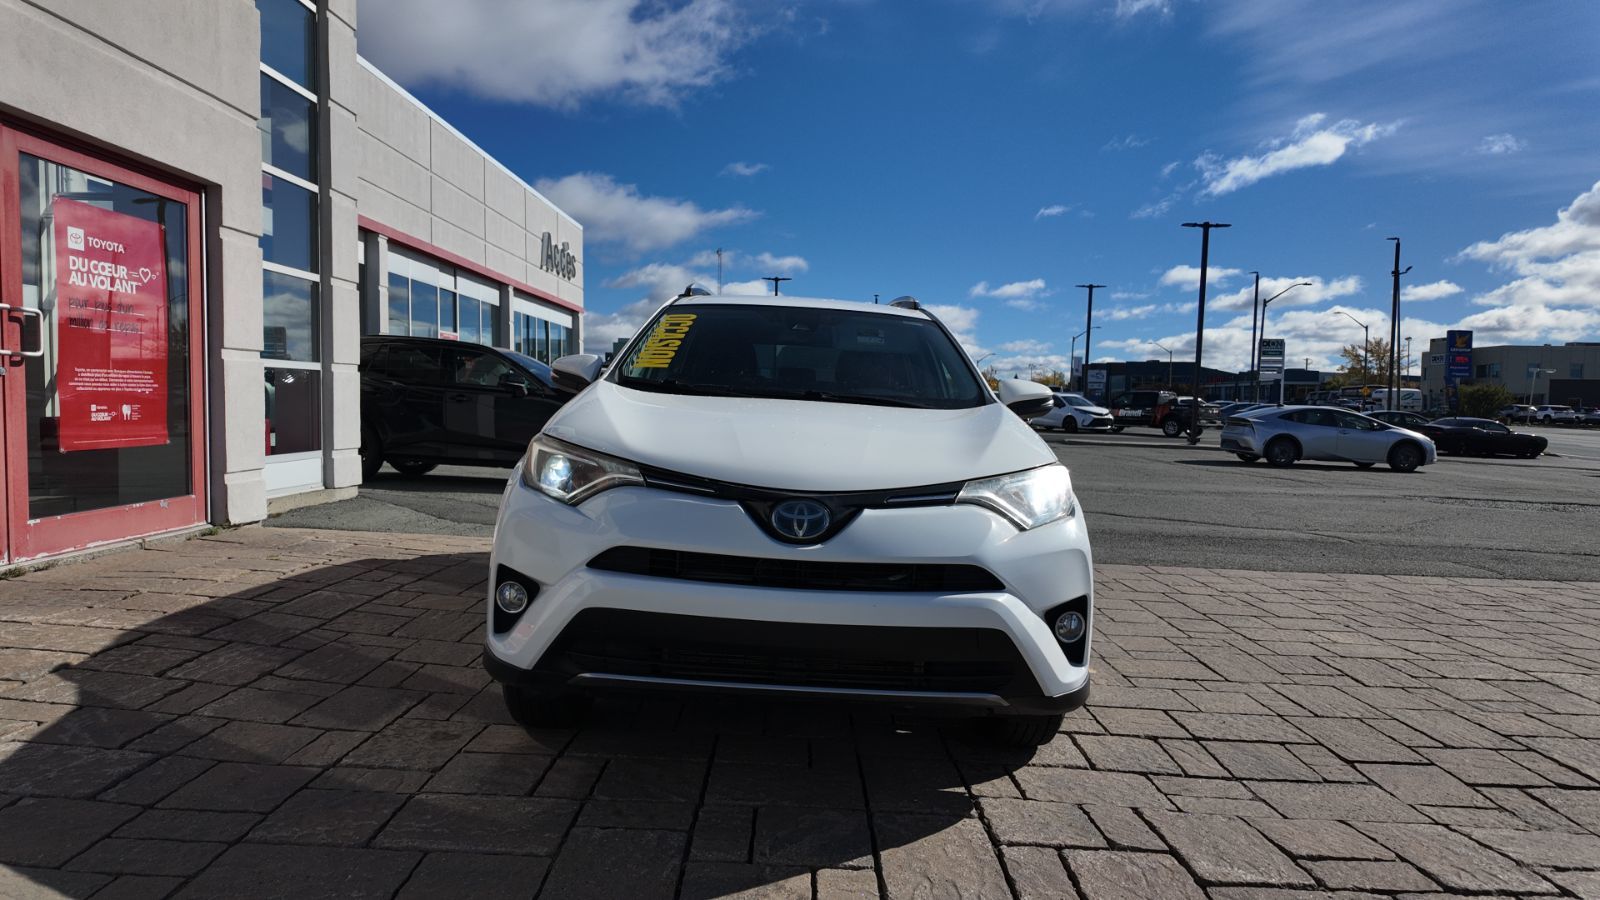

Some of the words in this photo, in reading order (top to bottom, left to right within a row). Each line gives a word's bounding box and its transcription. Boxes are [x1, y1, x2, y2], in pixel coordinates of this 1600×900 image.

[87, 236, 125, 254] TOYOTA
[540, 231, 576, 281] Accès
[69, 255, 88, 272] DU
[90, 260, 128, 279] CŒUR
[68, 271, 88, 287] AU
[88, 273, 138, 295] VOLANT
[633, 313, 697, 369] OCCASION
